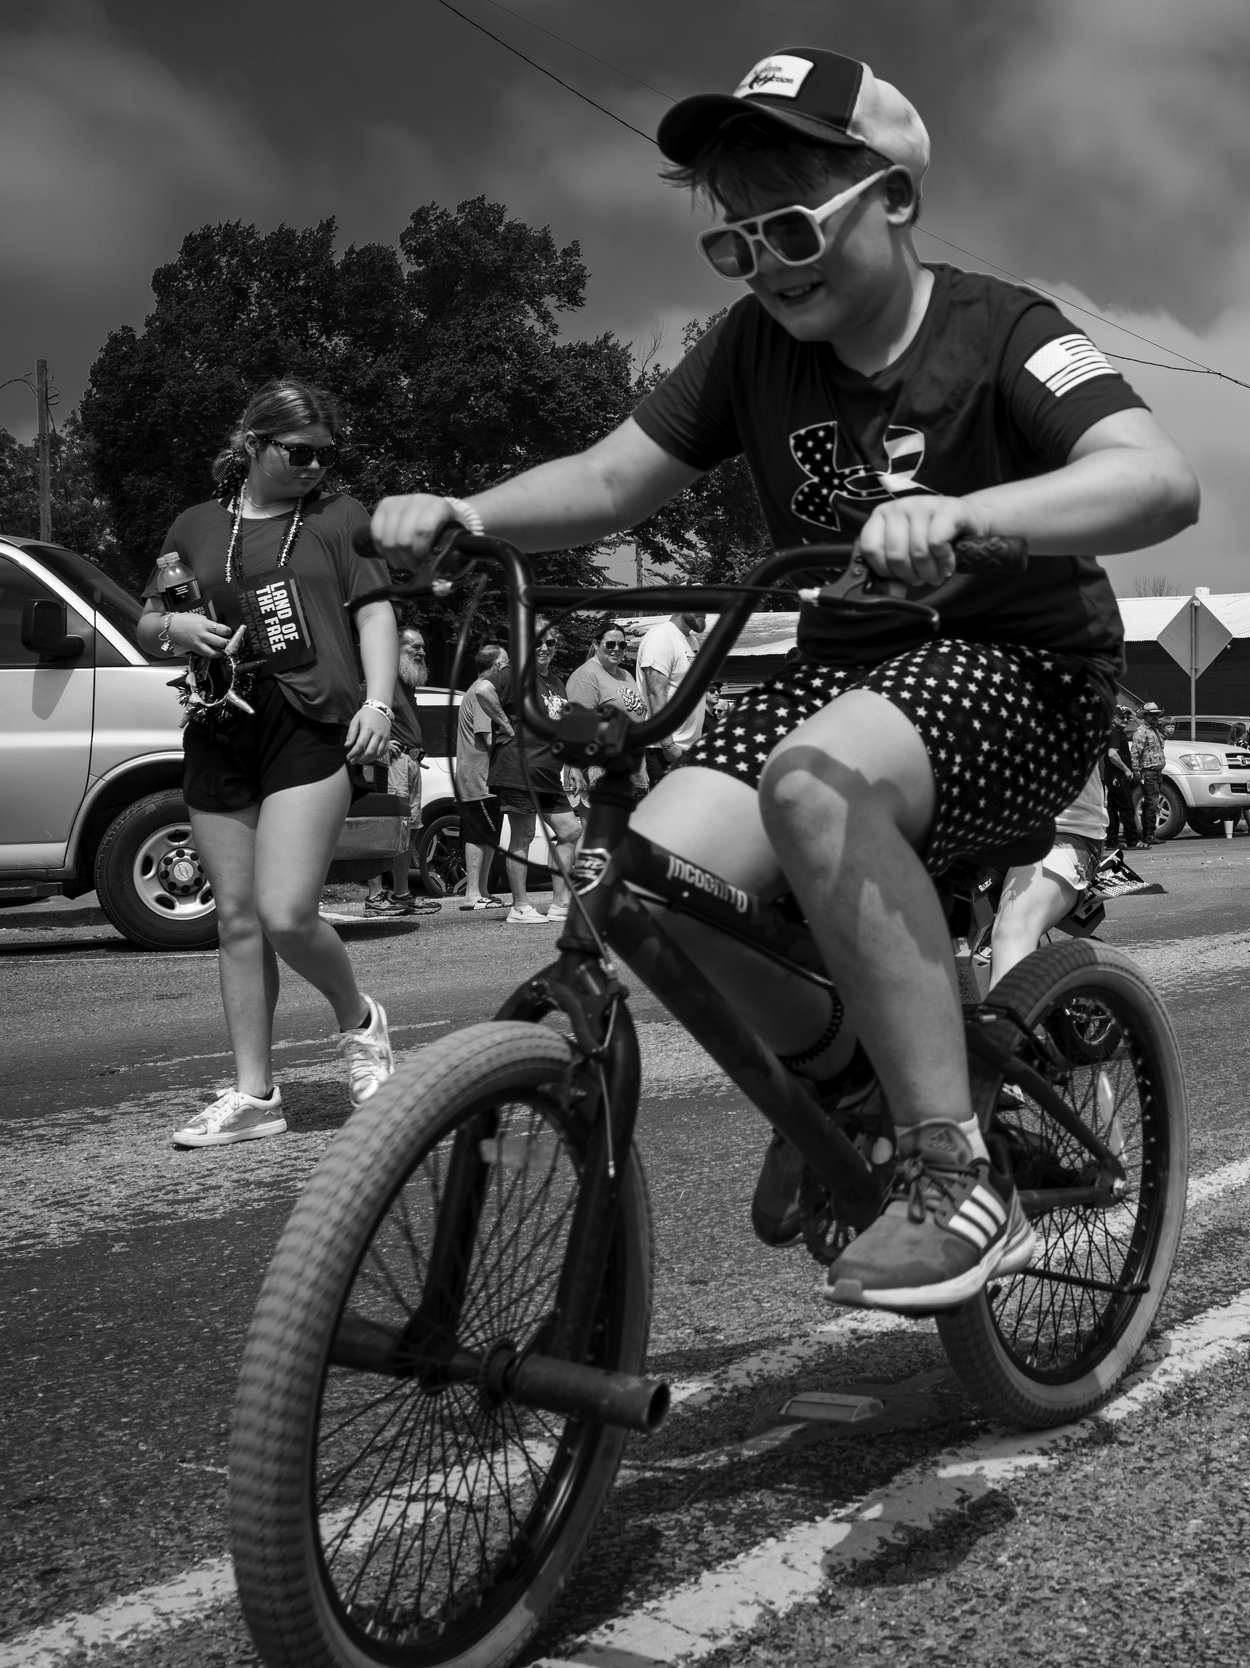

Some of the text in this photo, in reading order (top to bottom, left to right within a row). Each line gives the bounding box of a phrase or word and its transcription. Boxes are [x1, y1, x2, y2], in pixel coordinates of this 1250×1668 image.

[238, 592, 250, 614] THE
[246, 590, 272, 654] BECAUSE OF
[256, 585, 287, 653] THE FREE
[270, 581, 299, 641] LAND OF
